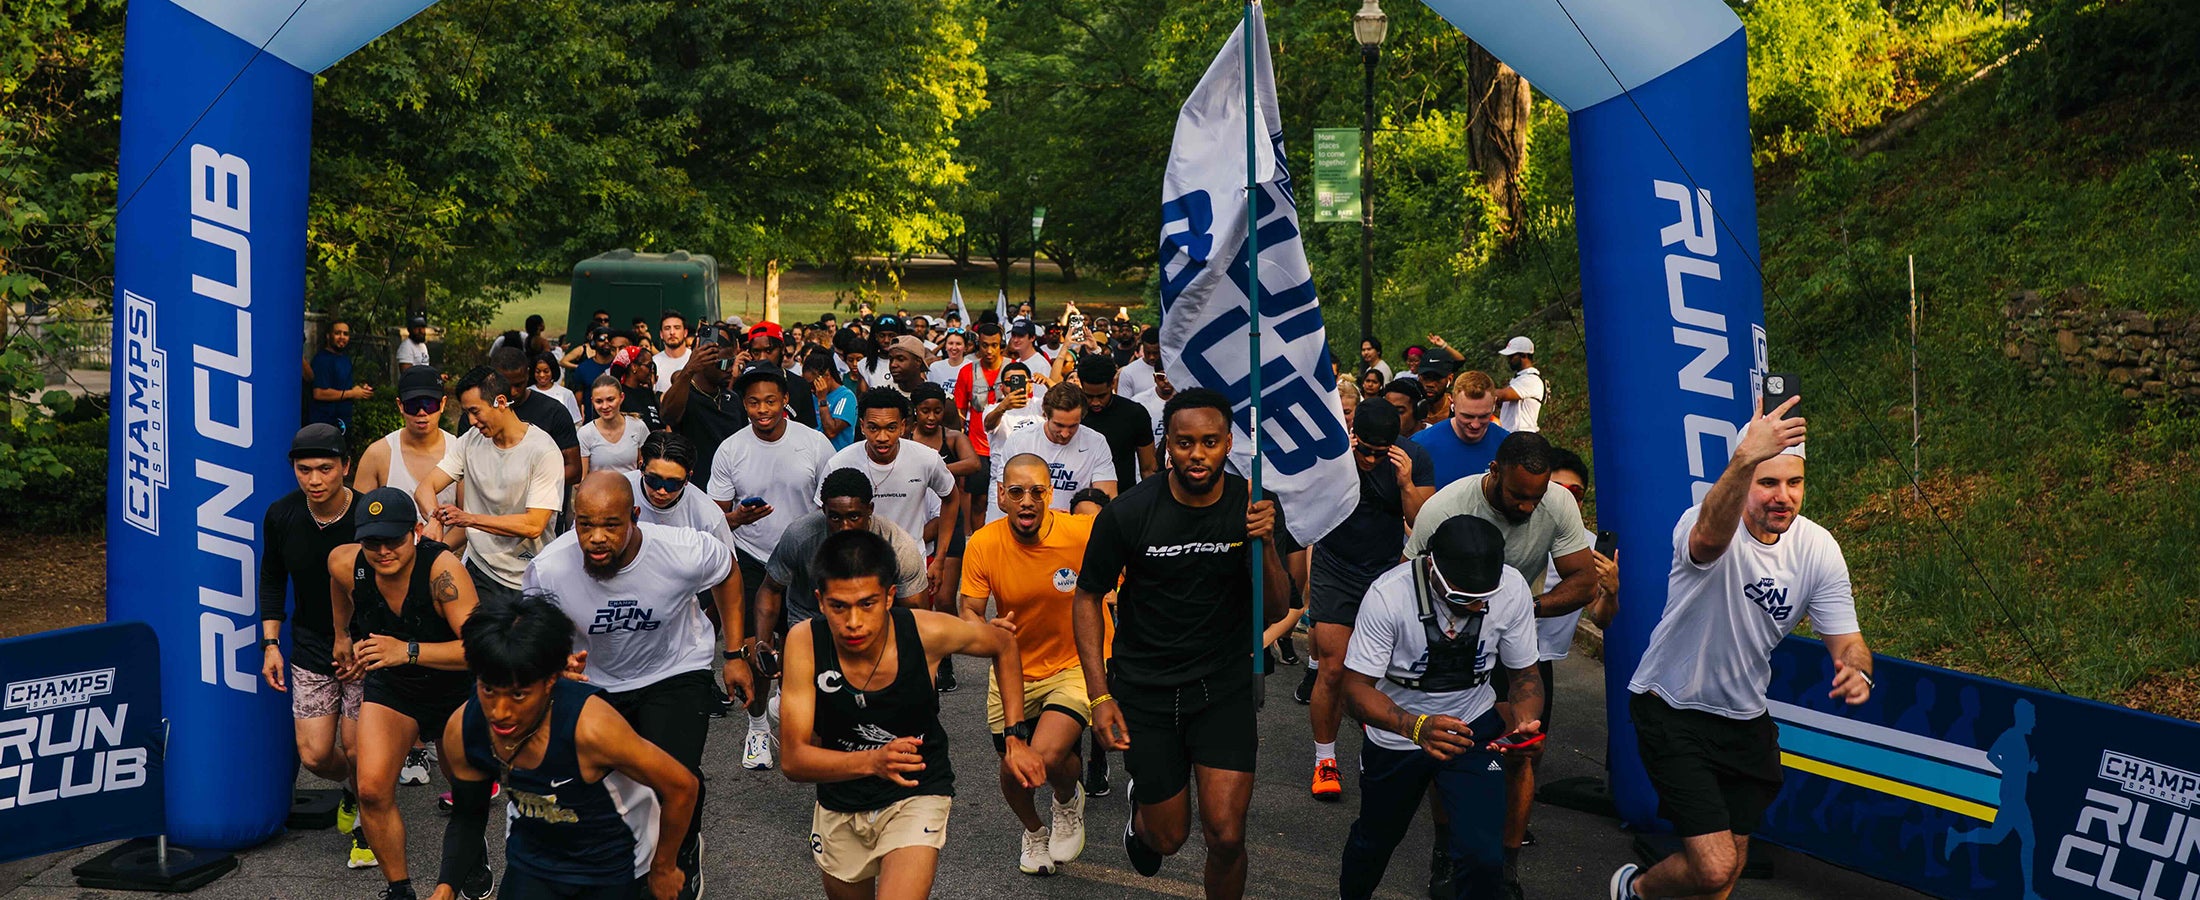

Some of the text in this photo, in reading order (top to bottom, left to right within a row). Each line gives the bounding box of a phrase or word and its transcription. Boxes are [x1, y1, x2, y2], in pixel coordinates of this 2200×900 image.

[1318, 142, 1339, 150] places
[1653, 179, 1735, 401] RUN
[1180, 304, 1350, 476] UB
[129, 305, 150, 520] CHAMPS
[151, 358, 162, 473] SPORTS
[190, 143, 257, 694] RUN CLUB
[1049, 469, 1074, 481] UN
[1053, 480, 1078, 491] UB
[1145, 542, 1231, 557] MOTION
[588, 620, 661, 635] CLUB
[594, 607, 653, 624] RUN
[11, 674, 109, 703] CHAMPS
[33, 693, 86, 707] SPORTS
[2105, 757, 2200, 798] CHAMP
[2128, 782, 2187, 803] SPORTS
[2052, 834, 2200, 900] CLU
